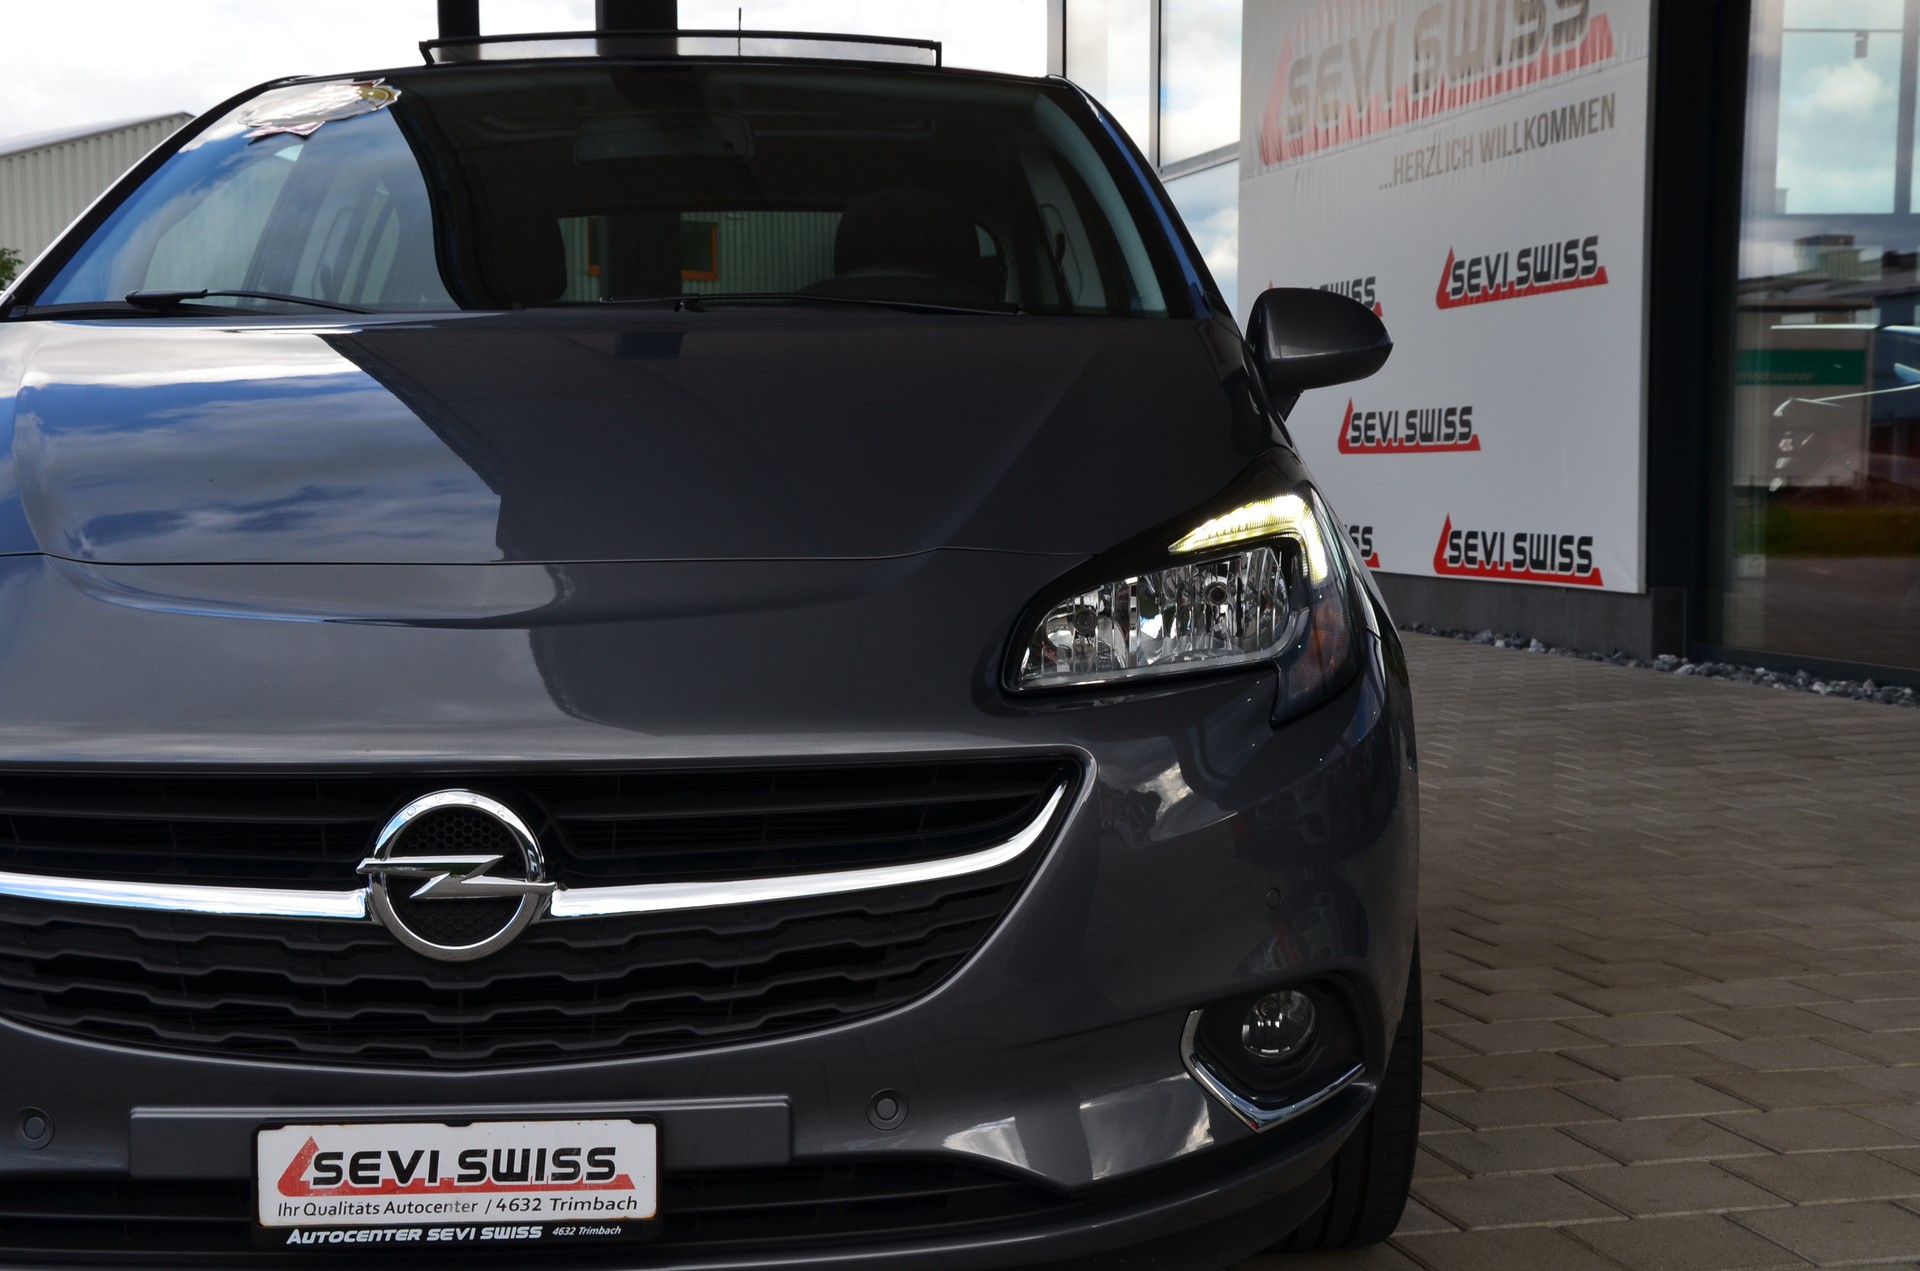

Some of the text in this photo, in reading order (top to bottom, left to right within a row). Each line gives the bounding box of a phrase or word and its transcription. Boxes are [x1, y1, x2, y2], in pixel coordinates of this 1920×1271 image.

[1287, 21, 1396, 138] SEVI
[1479, 92, 1616, 163] WILLKOMMEN
[1451, 235, 1598, 297] SEVI SWISS
[1350, 405, 1473, 444] SEVI SWISS
[1448, 530, 1594, 574] SEVI SWISS
[405, 793, 506, 819] OPEL
[312, 1146, 616, 1186] SEVI SWISS
[278, 1202, 301, 1217] Ihr
[303, 1201, 380, 1217] Qualitäts
[383, 1200, 478, 1215] Autocenter
[495, 1197, 542, 1212] 4632
[549, 1196, 638, 1212] Trimbach
[426, 1227, 477, 1242] SEVI
[479, 1225, 544, 1241] SWISS
[551, 1226, 577, 1237] 4632
[578, 1225, 622, 1236] Trimbach
